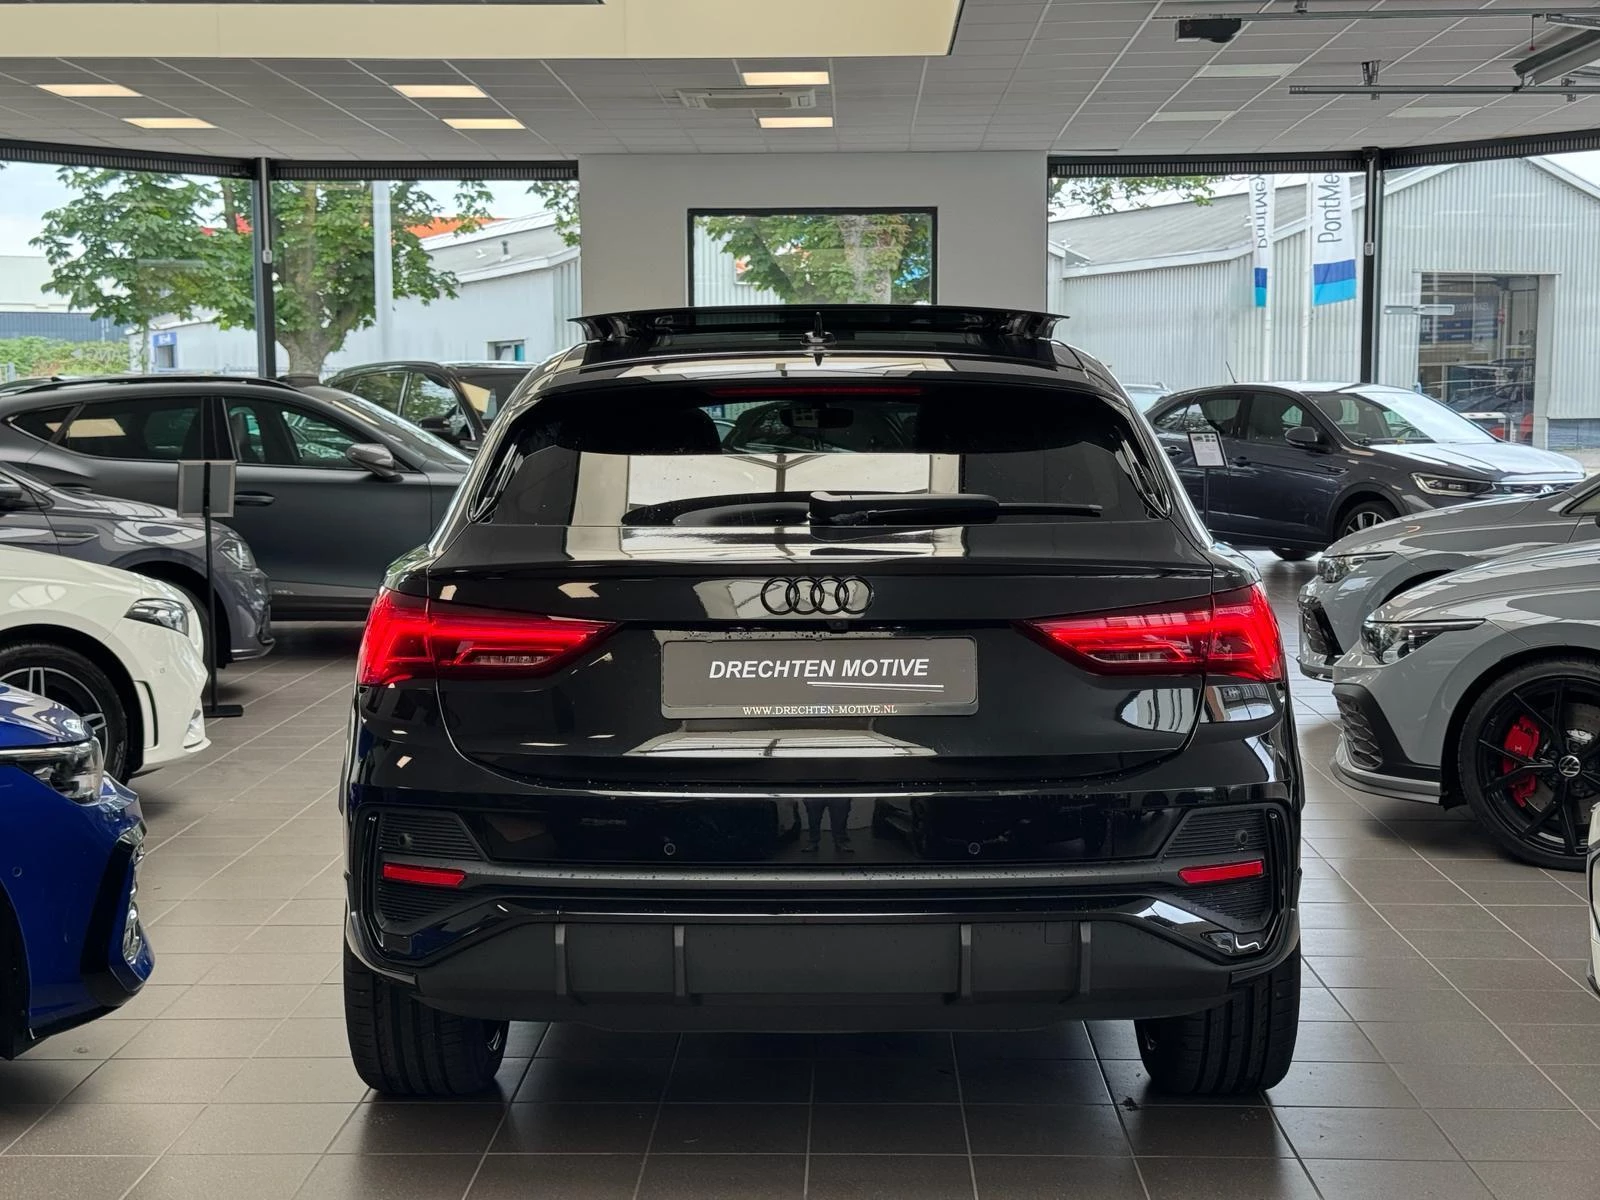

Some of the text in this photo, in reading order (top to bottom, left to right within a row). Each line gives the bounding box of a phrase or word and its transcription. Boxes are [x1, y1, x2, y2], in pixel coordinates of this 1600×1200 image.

[709, 658, 930, 679] DRECHTEN MOTIVE
[742, 704, 898, 716] WWW.DRECHTEN-MOTIVE.NL
